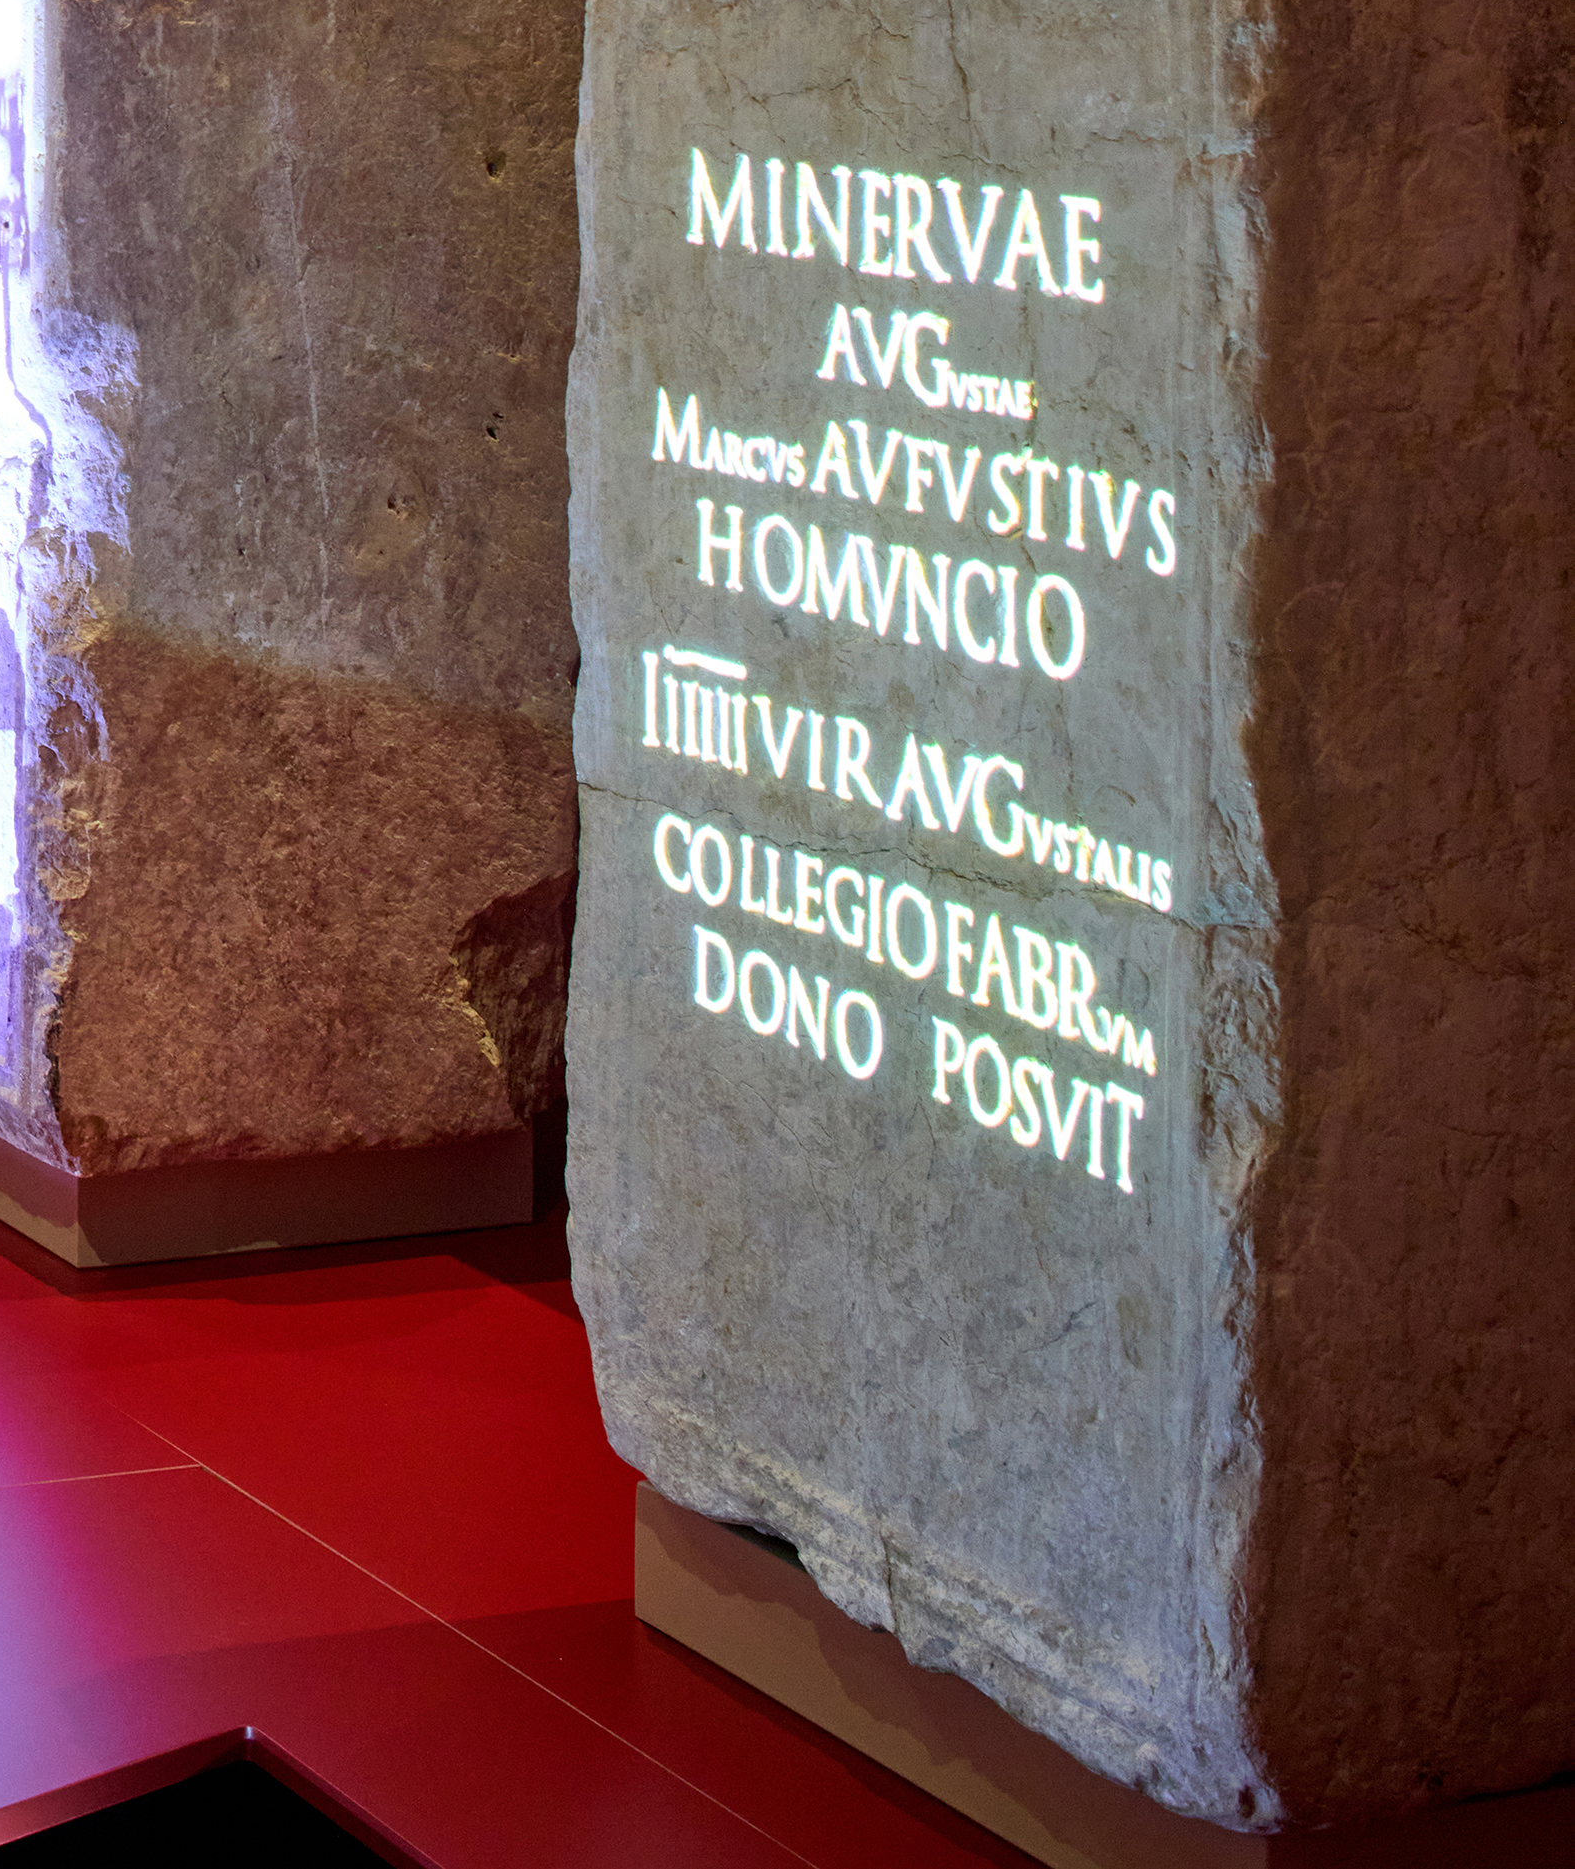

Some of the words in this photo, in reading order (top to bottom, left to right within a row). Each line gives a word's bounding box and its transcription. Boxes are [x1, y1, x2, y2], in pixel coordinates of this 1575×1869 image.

[685, 147, 1105, 305] MINERVAE
[696, 497, 1088, 681] HOMVNCIO
[652, 812, 938, 980] COLLEGIO
[692, 923, 884, 1081] DONO
[931, 1014, 1145, 1195] POSVIT
